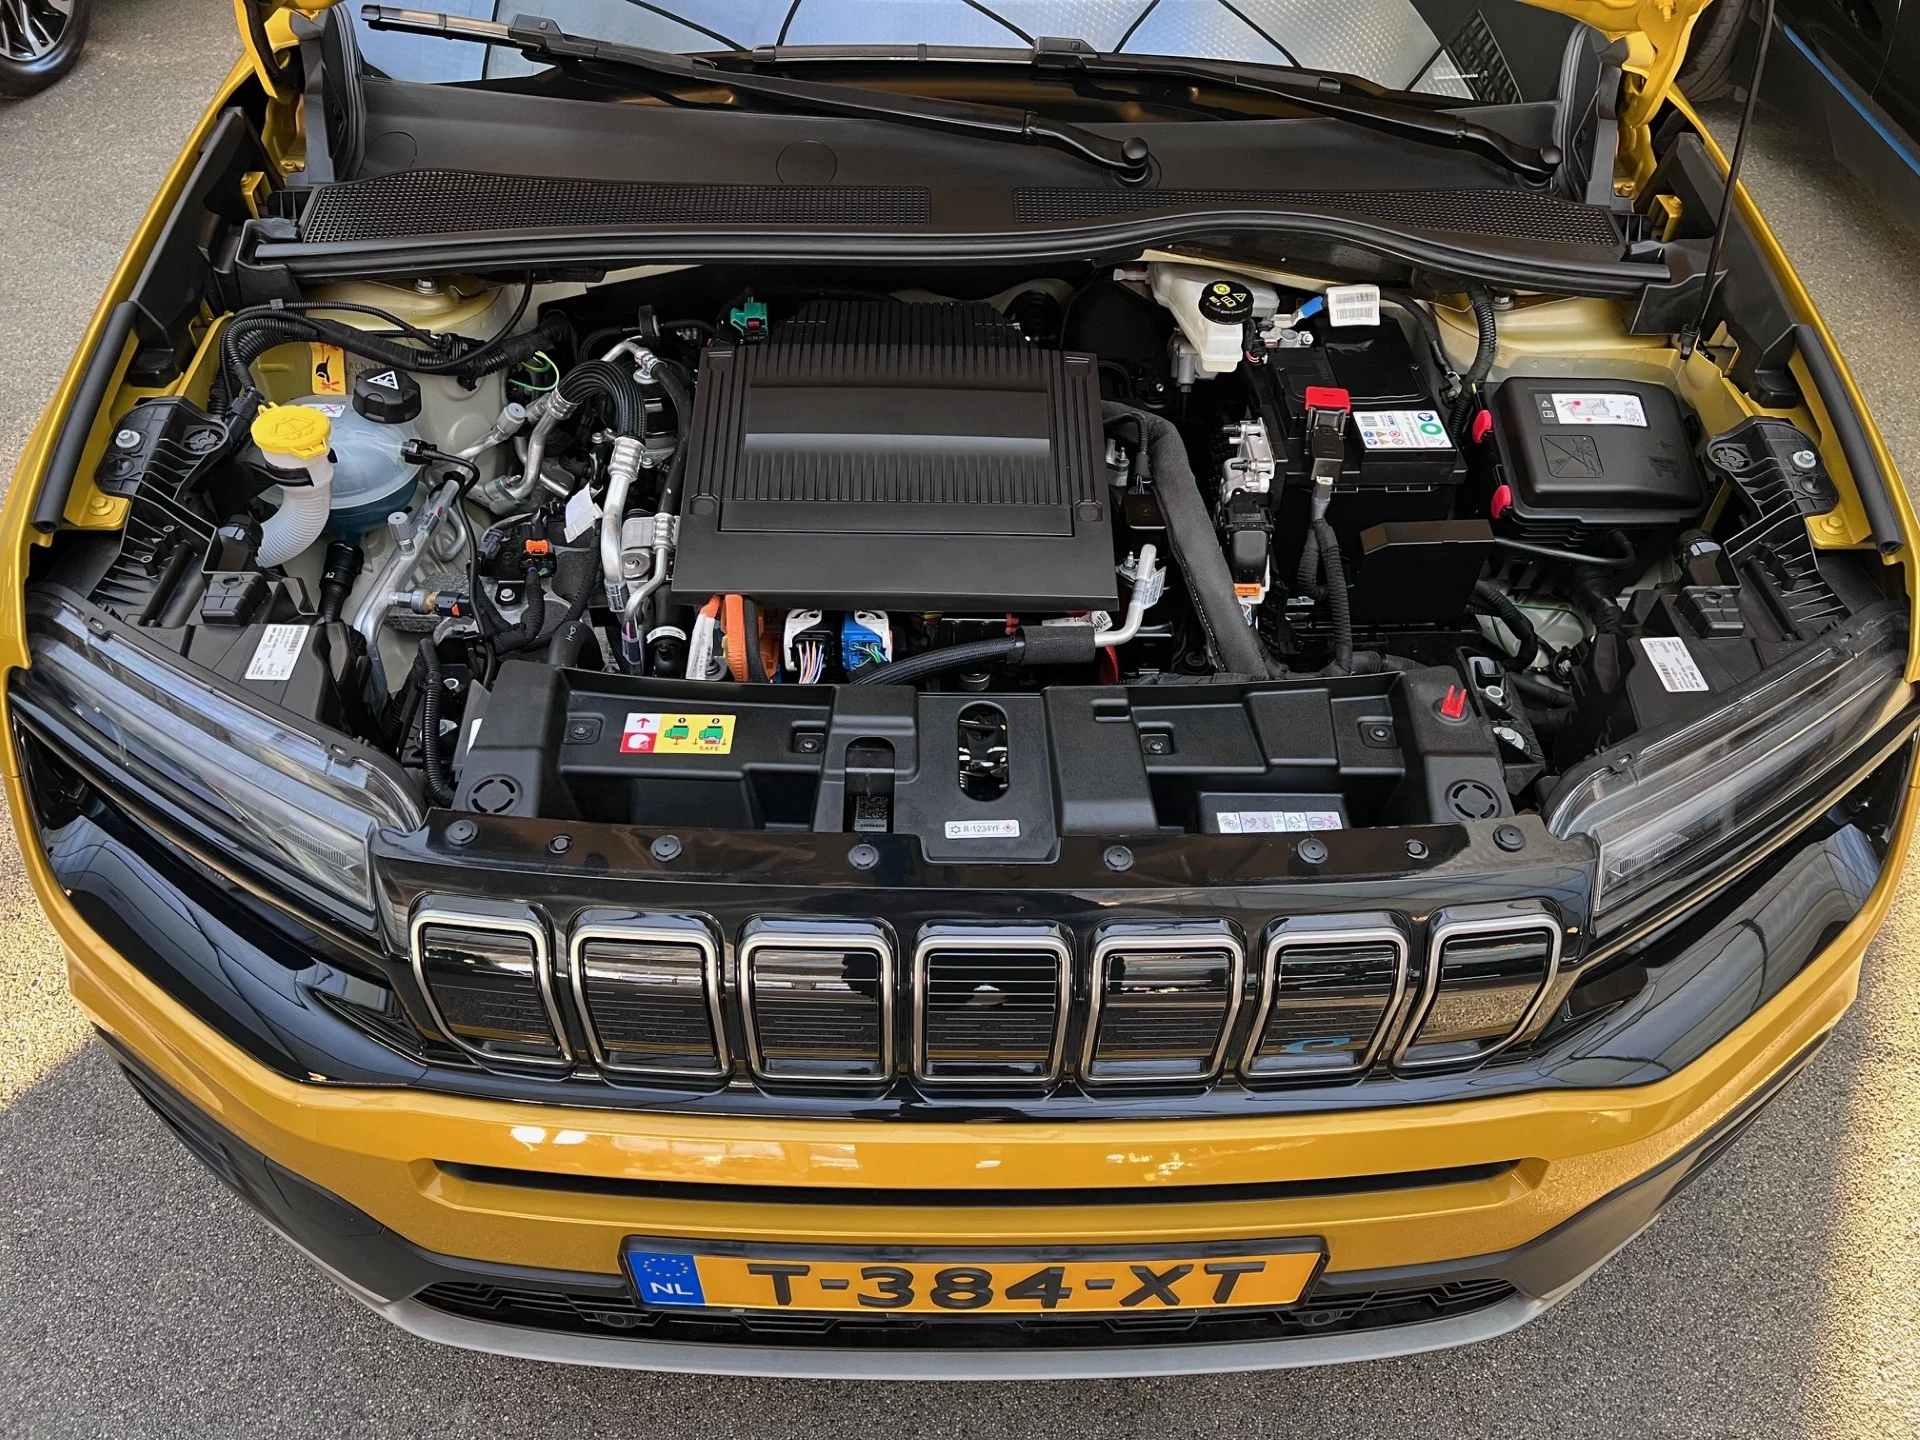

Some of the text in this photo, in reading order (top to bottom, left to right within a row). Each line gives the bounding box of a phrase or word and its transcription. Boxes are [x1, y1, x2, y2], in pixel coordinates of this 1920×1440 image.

[963, 825, 1001, 833] R-1234YF
[650, 1282, 694, 1296] NL
[747, 1262, 1266, 1310] T-384-XT
